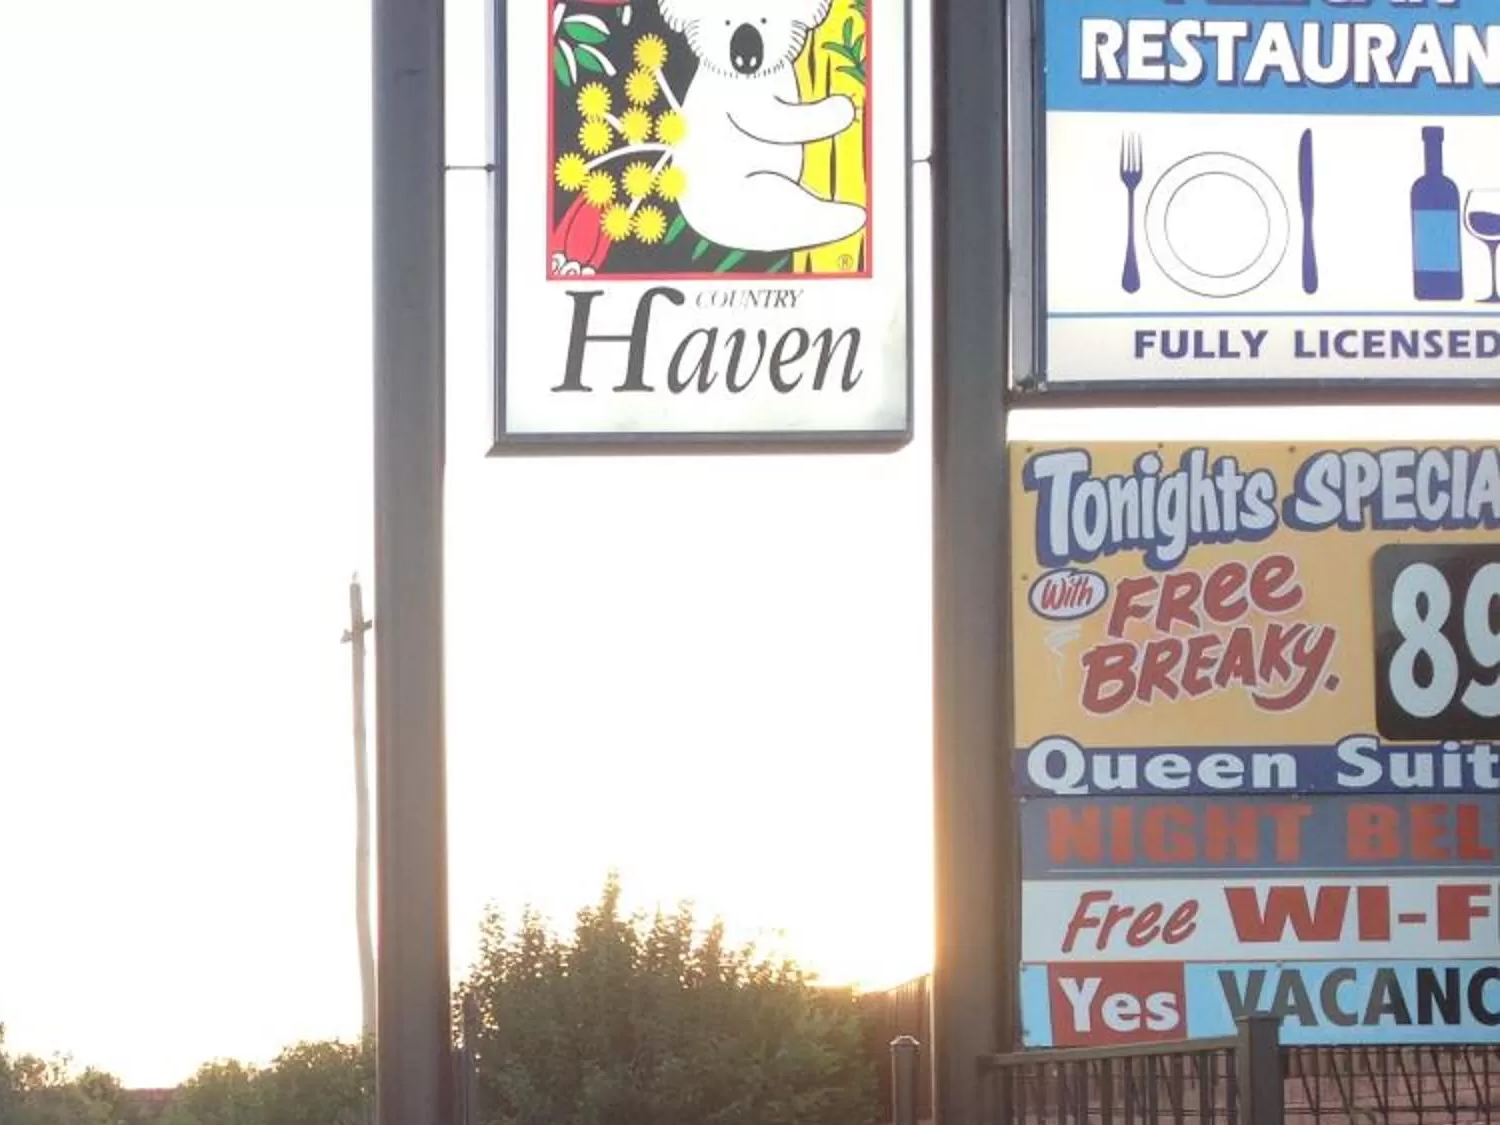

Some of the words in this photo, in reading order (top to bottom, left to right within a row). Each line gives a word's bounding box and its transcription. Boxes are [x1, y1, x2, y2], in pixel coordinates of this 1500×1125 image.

[695, 288, 804, 310] COUNTRY
[550, 286, 863, 394] Haven
[1134, 329, 1268, 359] FULLY
[1294, 329, 1500, 359] LICENSED
[1024, 446, 1280, 570] Tonights
[1041, 576, 1093, 611] With
[1026, 739, 1298, 794] Queen
[1336, 737, 1500, 789] Suit
[1045, 803, 1313, 864] NIGHT
[1347, 803, 1500, 863] BEL
[1061, 890, 1200, 953] Free
[1224, 884, 1500, 942] WI-F
[1058, 977, 1179, 1033] Yes
